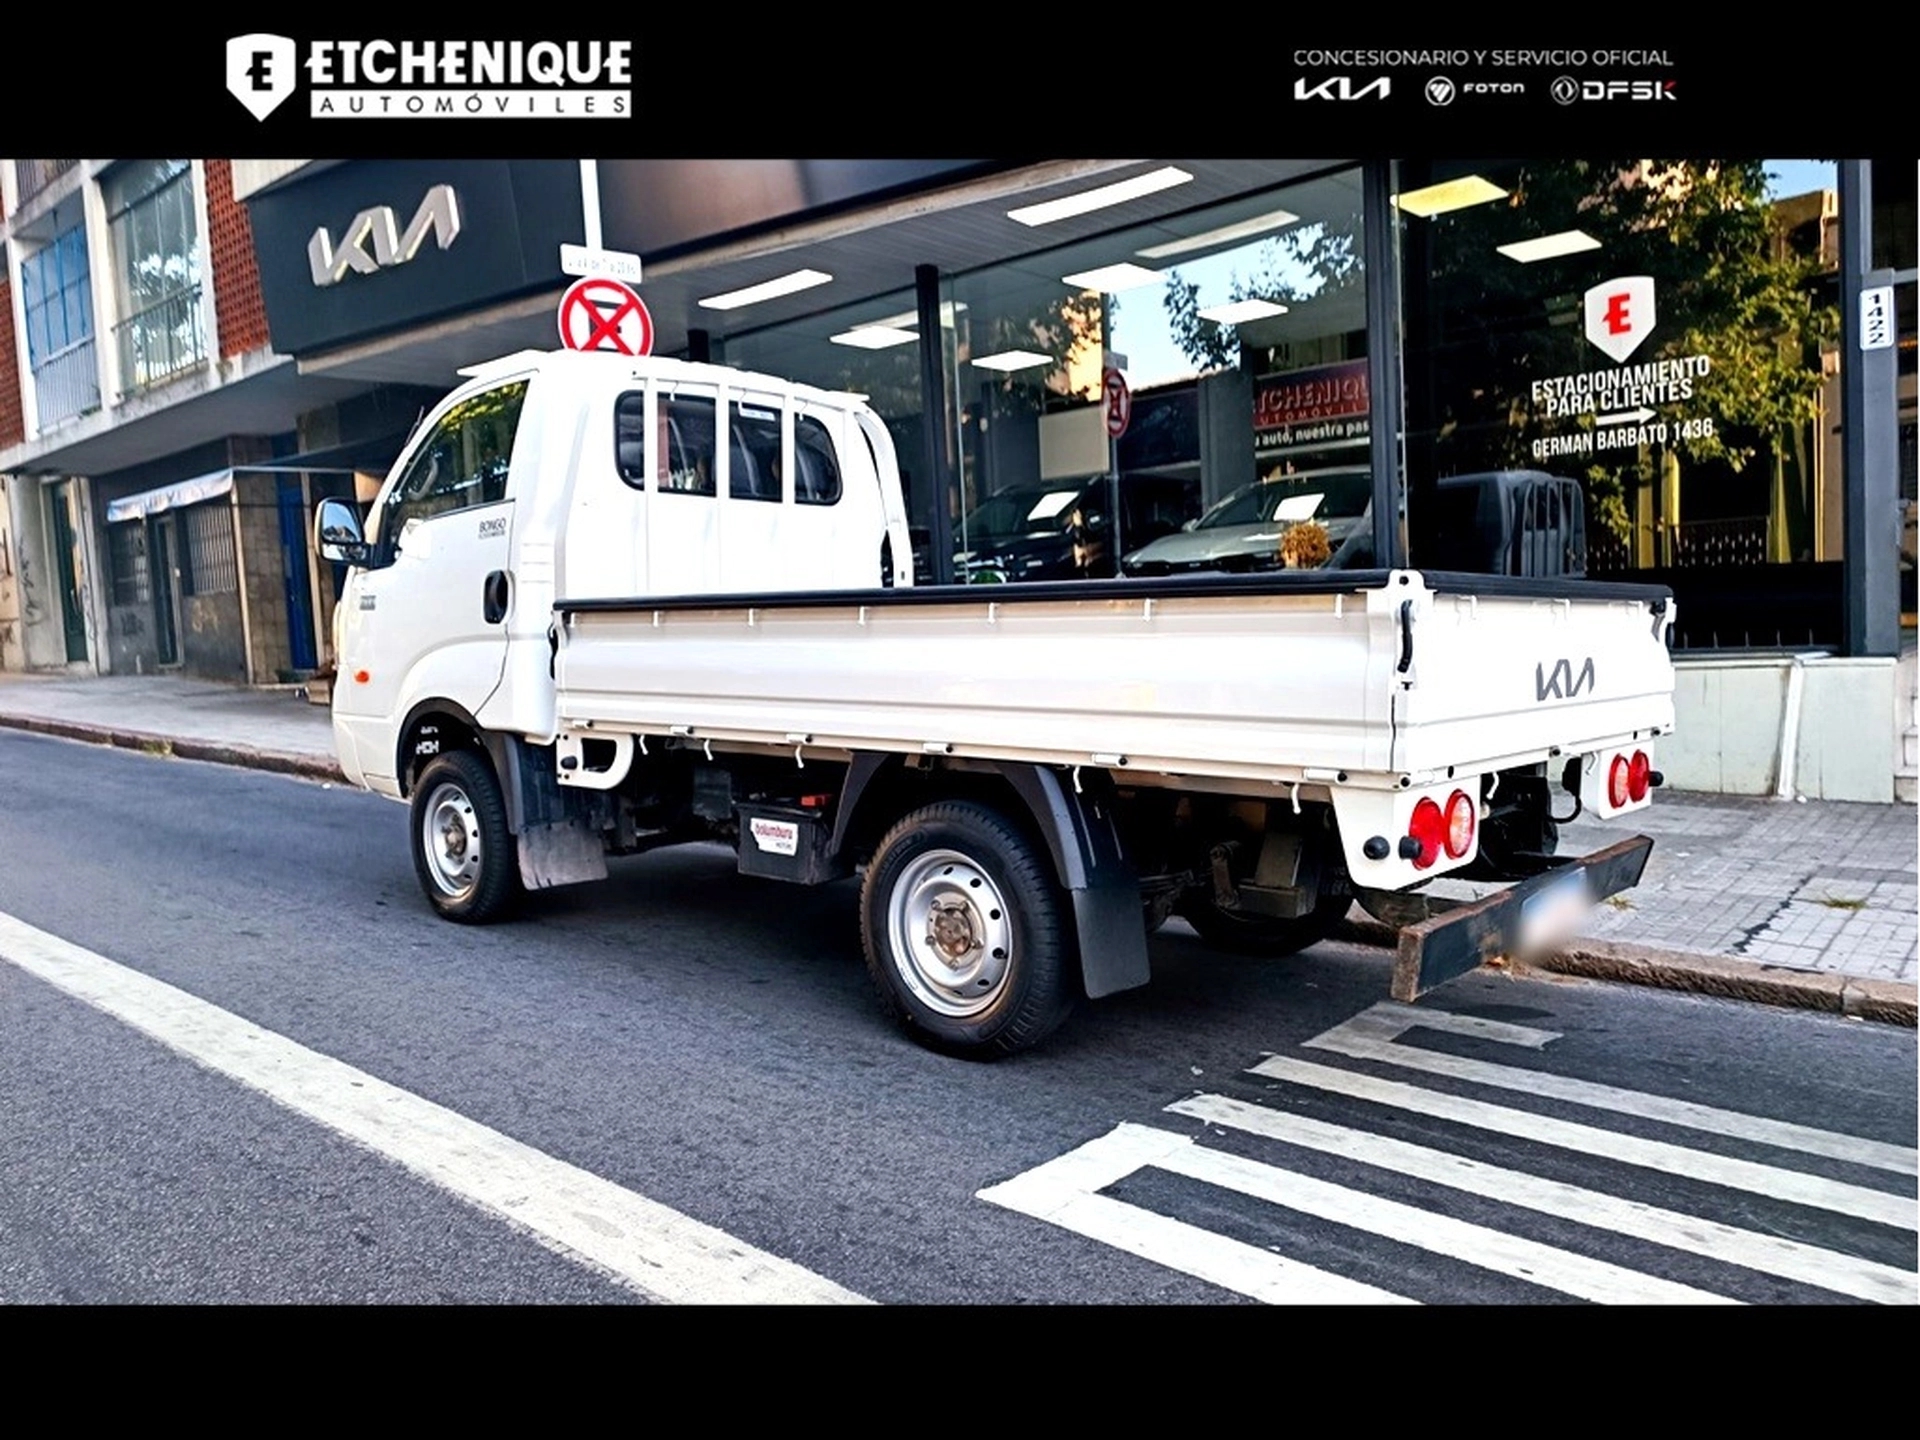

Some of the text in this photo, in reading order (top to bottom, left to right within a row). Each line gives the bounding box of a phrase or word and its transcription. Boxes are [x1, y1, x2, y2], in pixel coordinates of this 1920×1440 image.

[1867, 293, 1885, 345] 1422
[1532, 355, 1710, 402] ESTACIONAMIENTO
[1547, 379, 1693, 418] PARA CLIENTES
[1296, 422, 1344, 441] nuestra
[1532, 417, 1714, 459] GERMAN BARBATO 1436
